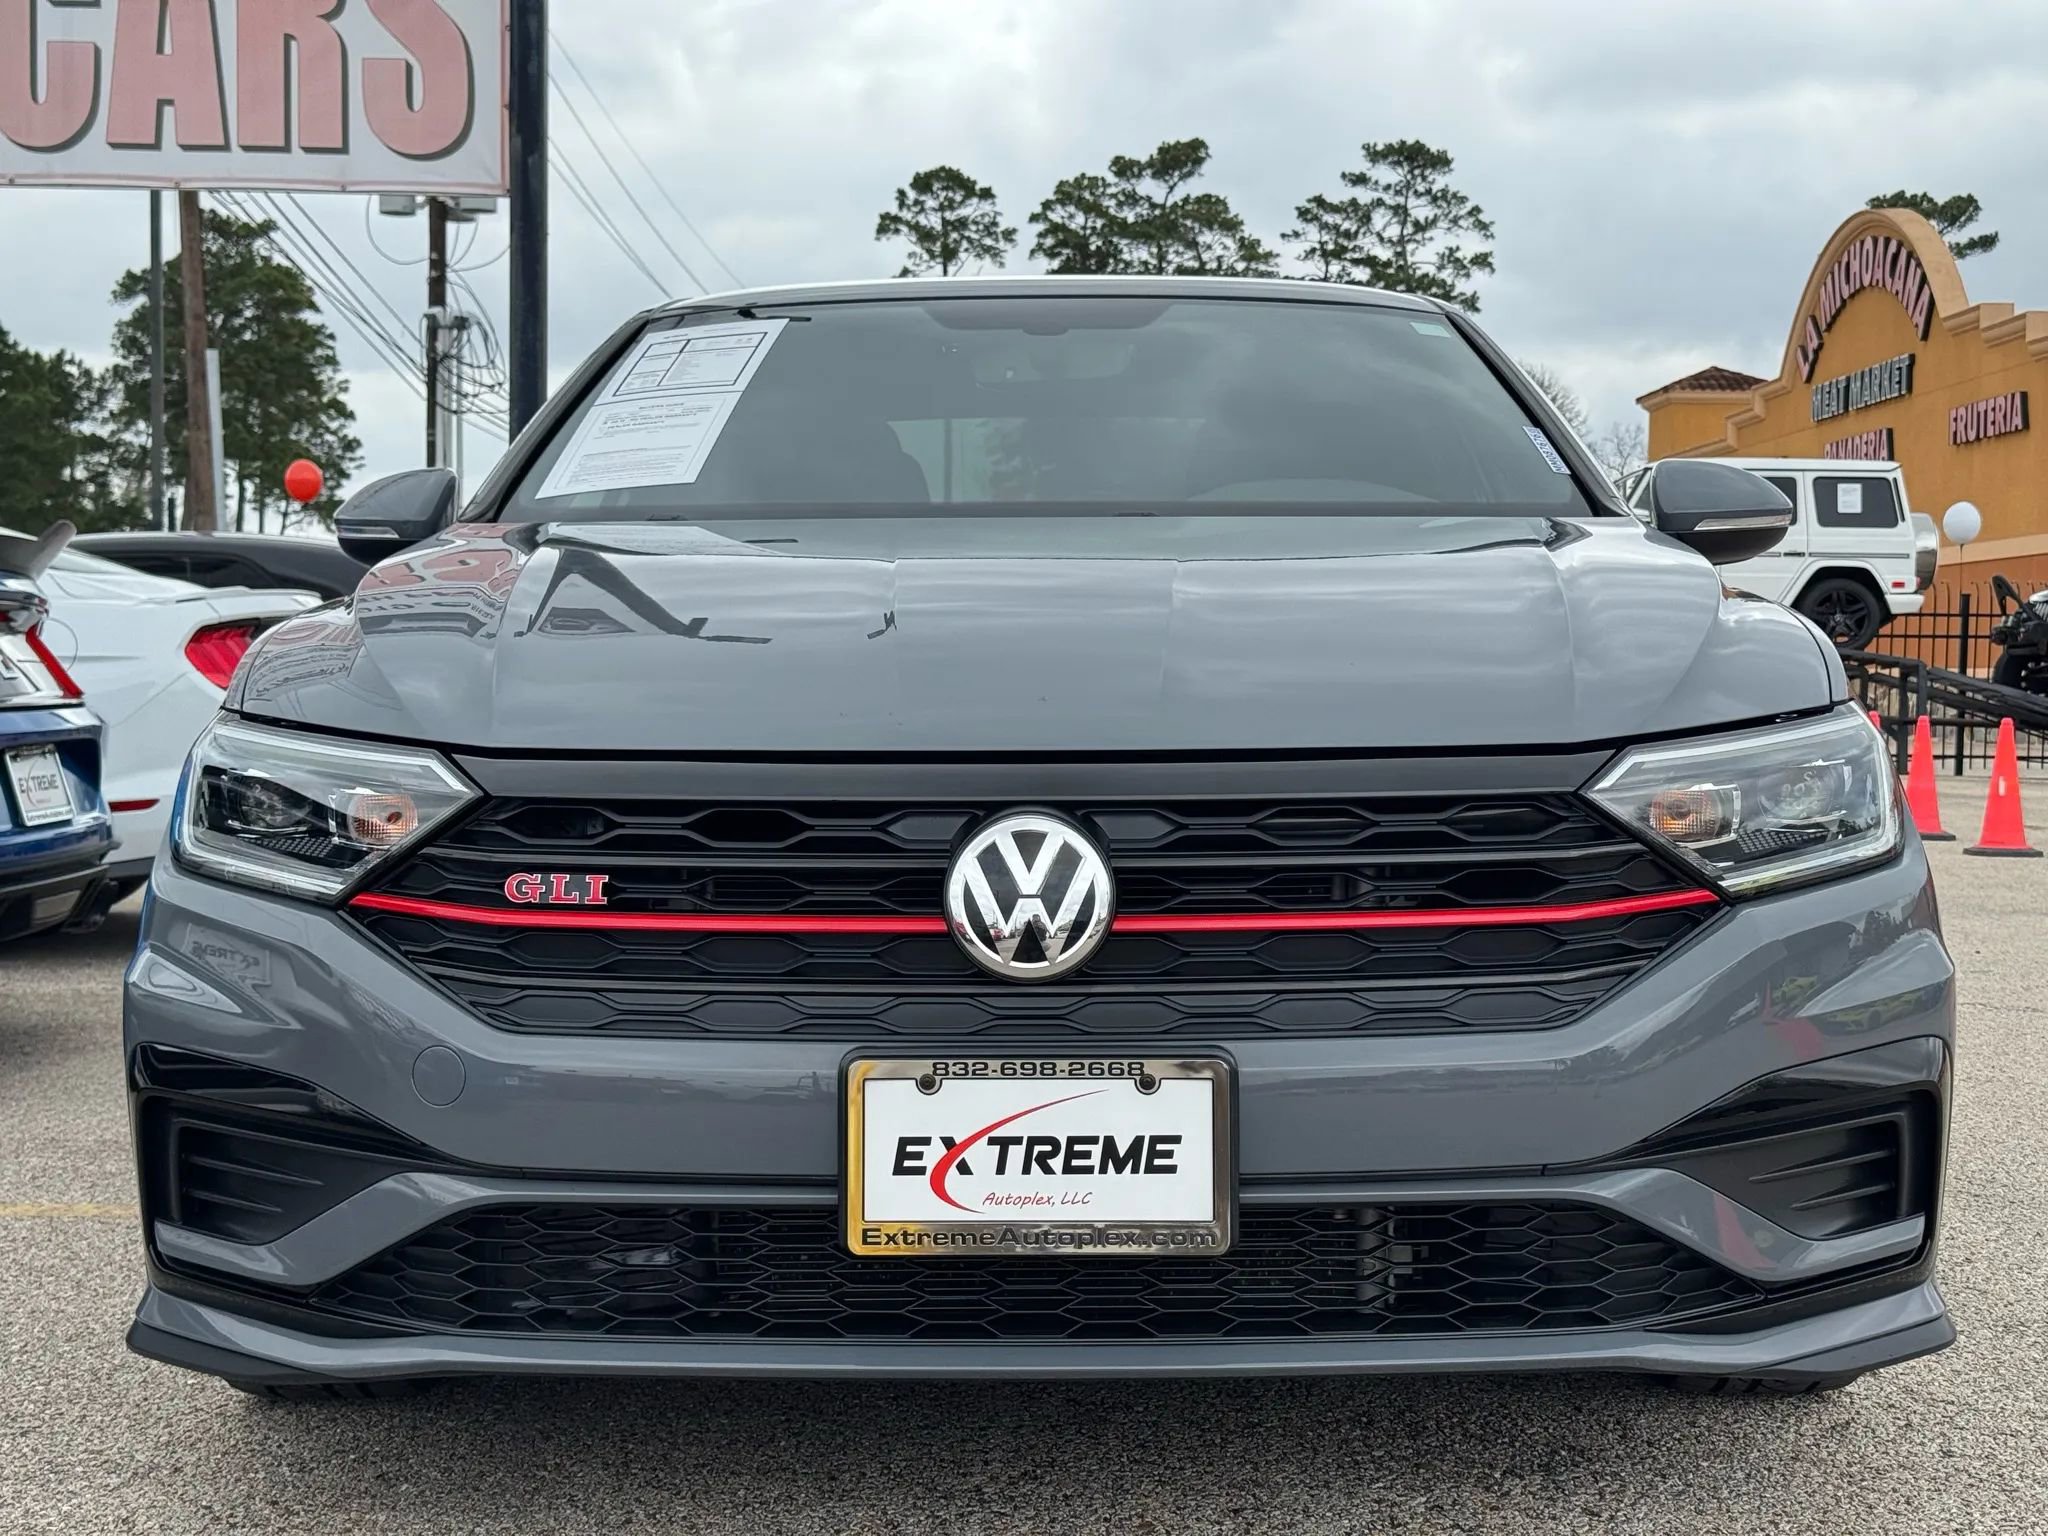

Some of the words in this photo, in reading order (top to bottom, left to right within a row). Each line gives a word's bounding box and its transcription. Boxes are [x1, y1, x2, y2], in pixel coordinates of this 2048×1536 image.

[0, 0, 474, 161] CARS
[1797, 315, 1823, 383] LA
[1819, 235, 1934, 342] MICHOACANA
[1811, 375, 1849, 423] MEAT
[1849, 353, 1913, 411] MARKET
[1949, 391, 2027, 446] FRUTERIA
[18, 774, 59, 794] EXTREME
[504, 873, 609, 905] GLI
[931, 1061, 1145, 1077] 832-698-2668
[892, 1134, 1183, 1177] EXTREME
[982, 1191, 1057, 1208] Autoplex,
[1061, 1191, 1094, 1206] LLC
[861, 1227, 1217, 1250] ExtremeAutoplex.com
